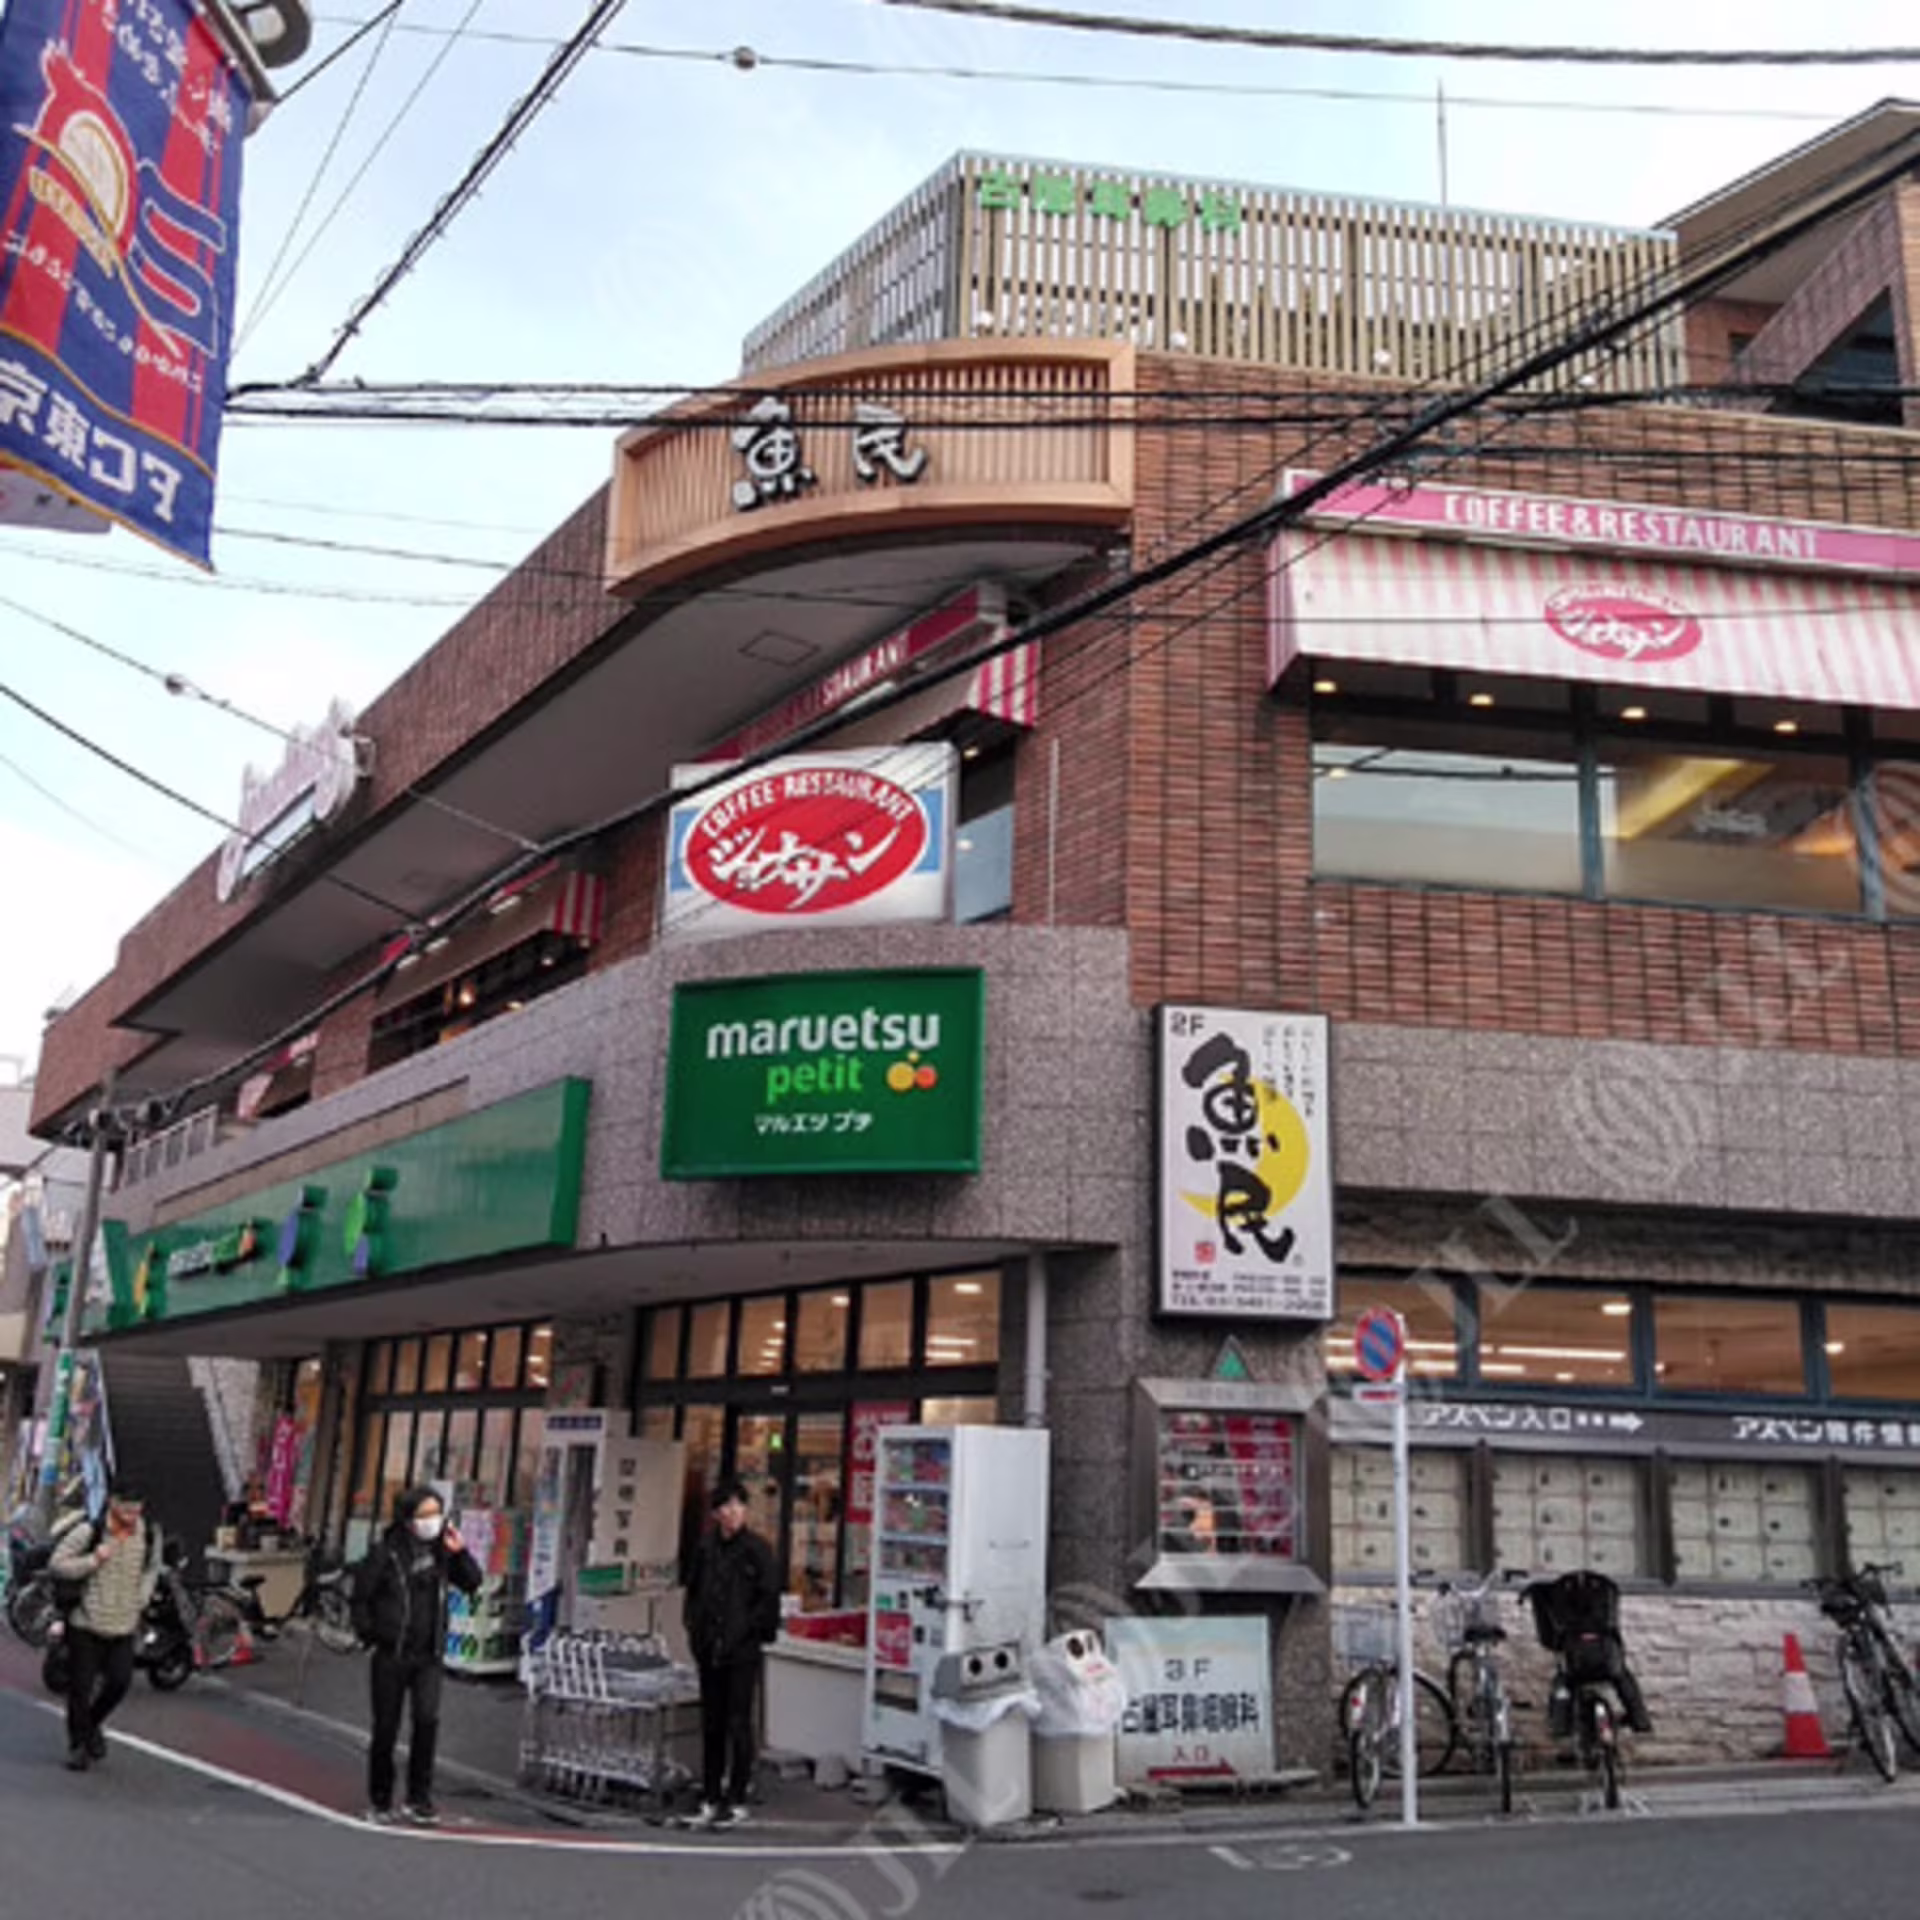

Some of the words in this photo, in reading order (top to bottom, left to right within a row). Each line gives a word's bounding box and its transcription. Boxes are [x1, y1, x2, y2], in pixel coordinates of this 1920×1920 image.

[732, 397, 928, 510] 魚民
[1444, 493, 1819, 559] COFFEE&RESTAURANT
[703, 780, 775, 839] COFFEE
[784, 771, 914, 821] RESTAURANT
[707, 1006, 940, 1059] maruetsu
[766, 1053, 863, 1105] petit
[1182, 1031, 1295, 1265] 魚民
[1423, 1401, 1572, 1432] アスペン入口
[1172, 1744, 1210, 1763] 入口
